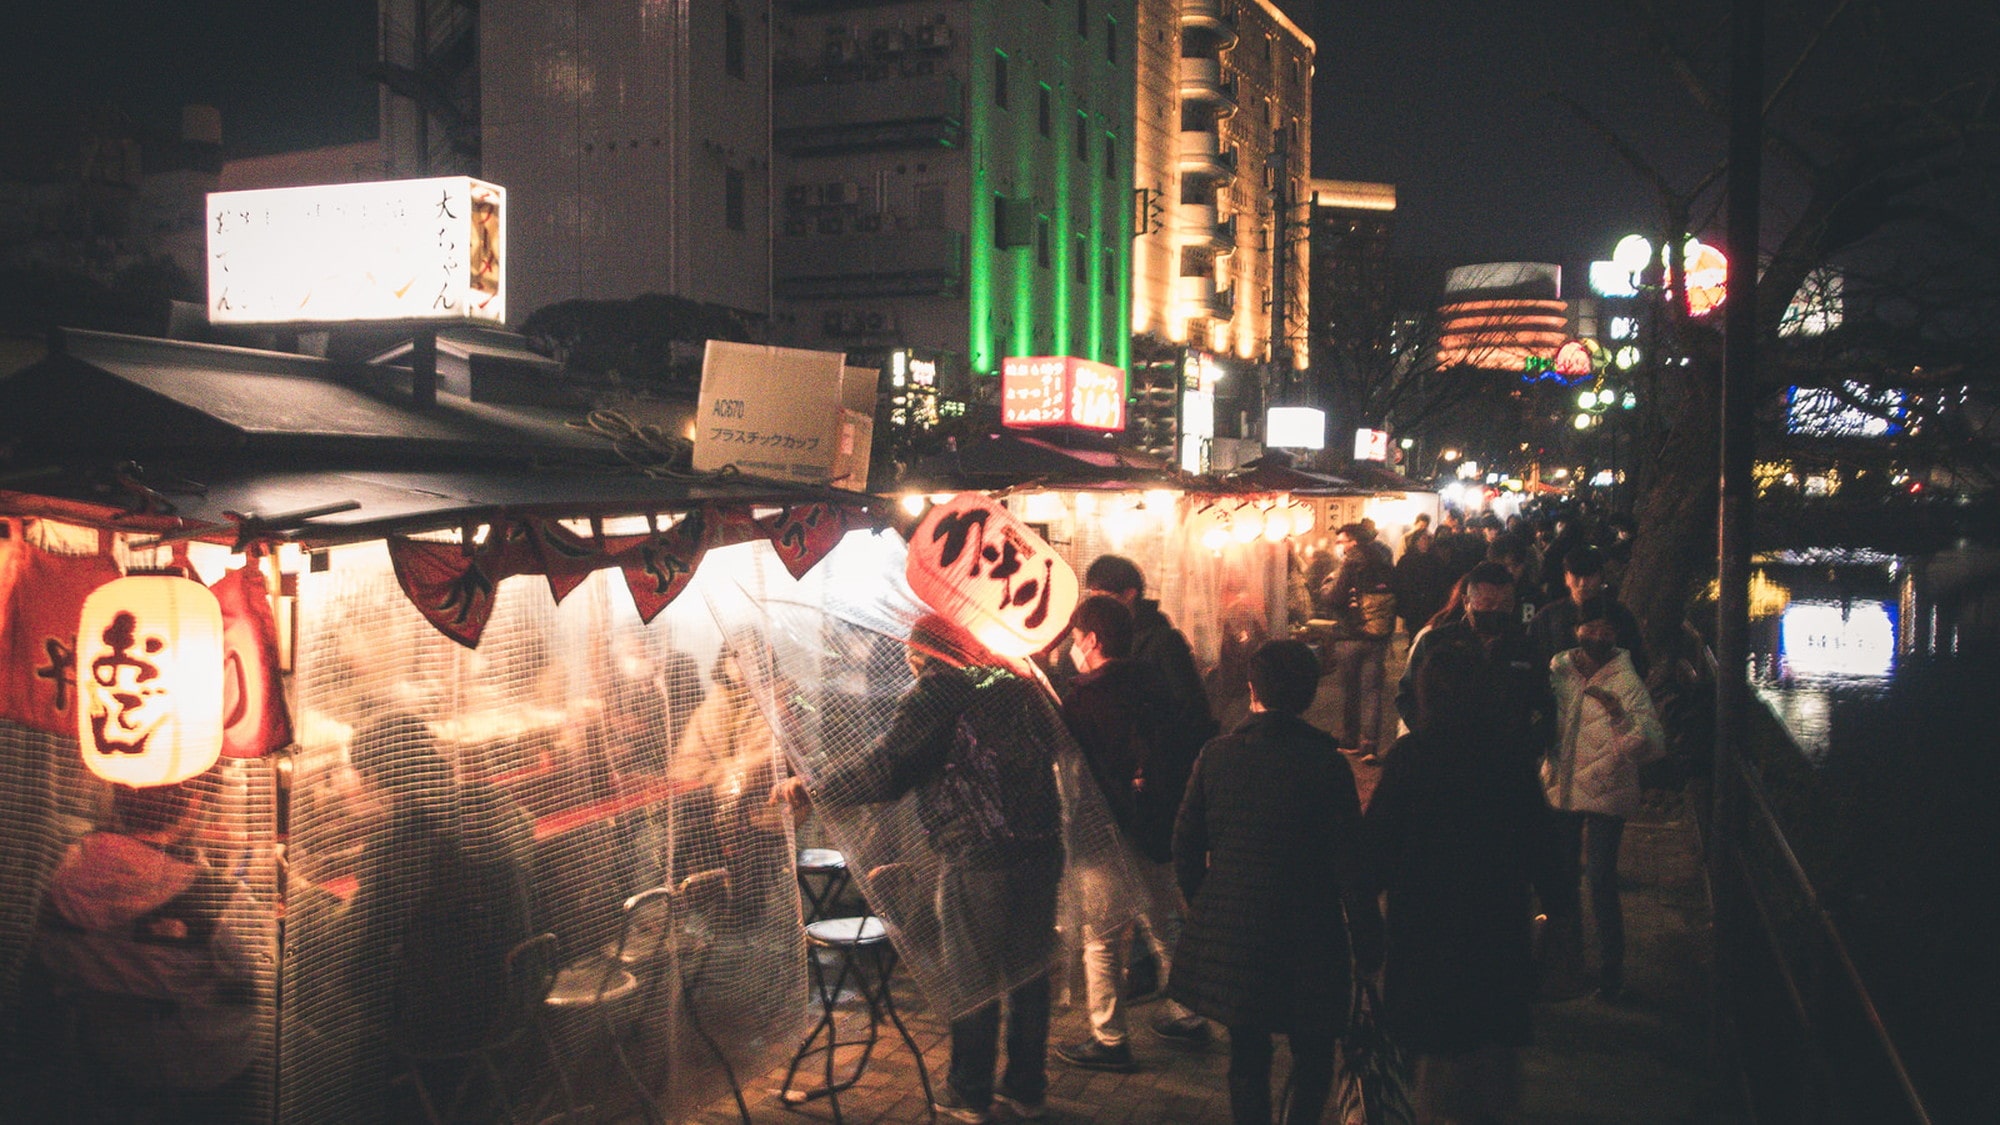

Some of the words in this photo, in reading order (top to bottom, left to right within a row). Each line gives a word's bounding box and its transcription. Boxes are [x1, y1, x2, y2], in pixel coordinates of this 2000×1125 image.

[712, 399, 745, 418] AC670
[710, 428, 820, 449] プラスチックカップ
[1522, 602, 1535, 622] B
